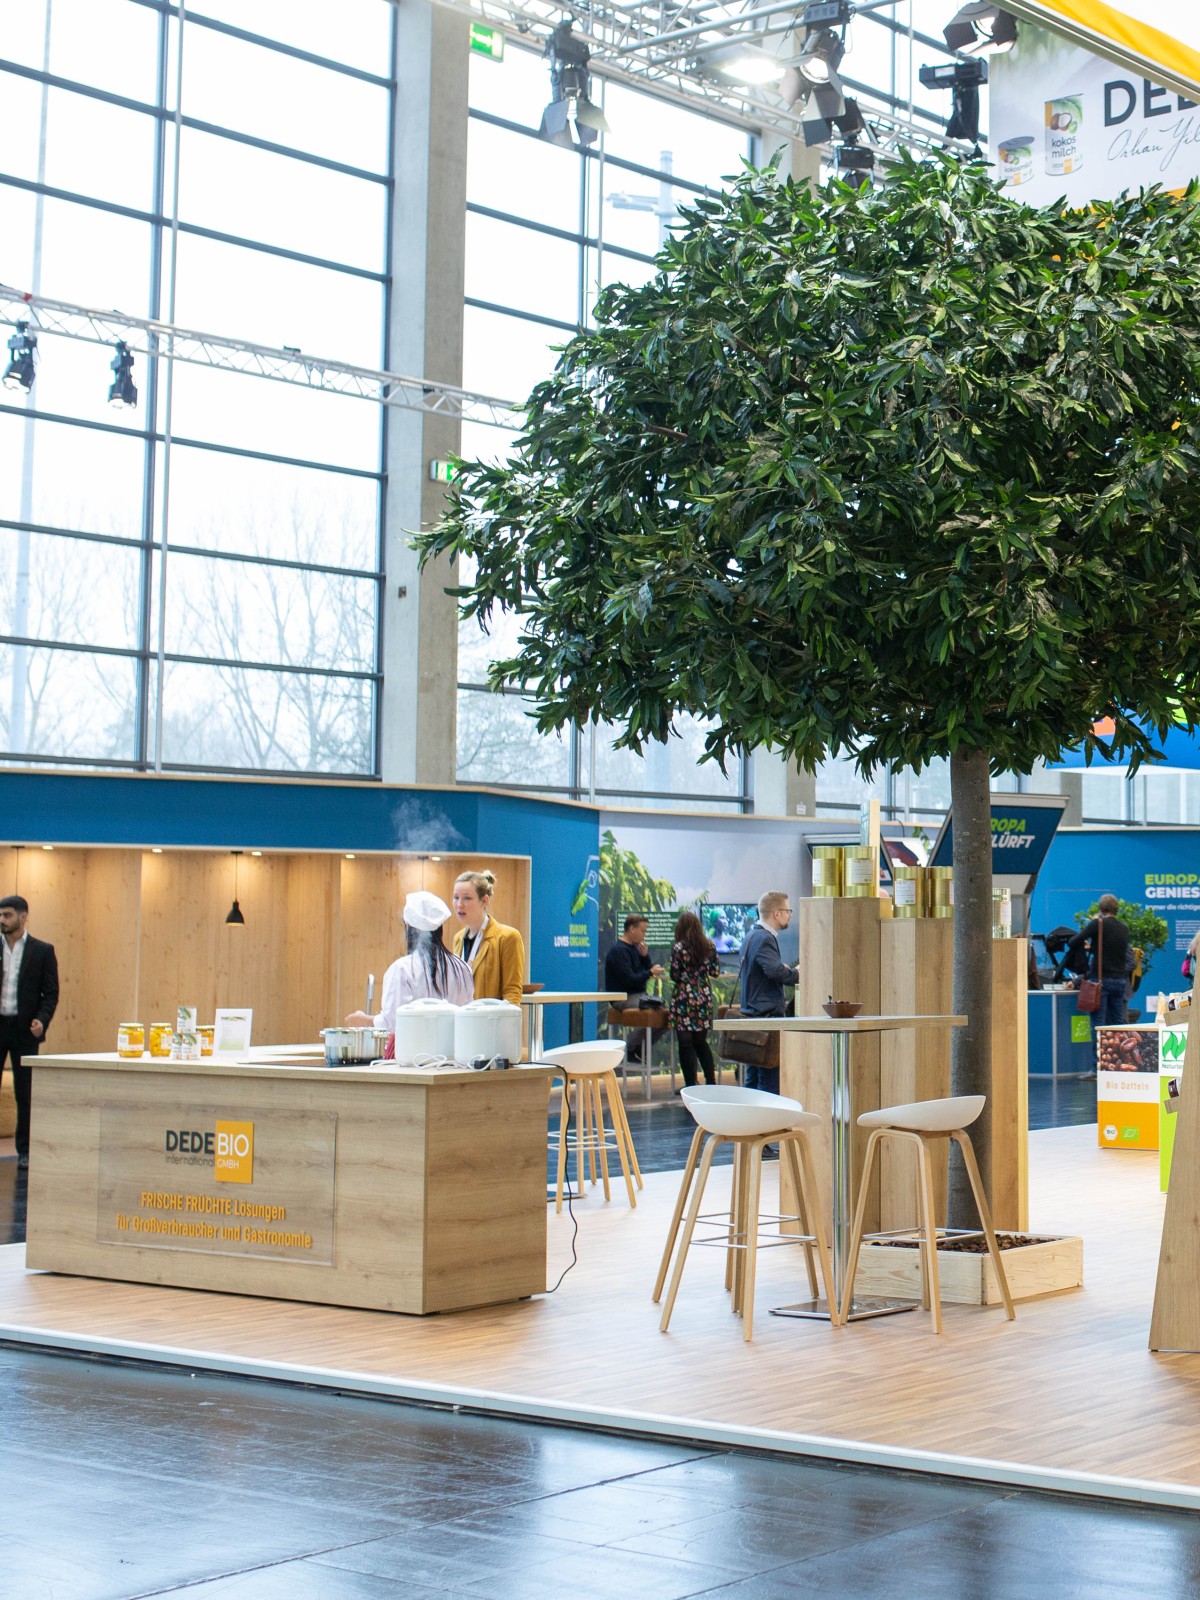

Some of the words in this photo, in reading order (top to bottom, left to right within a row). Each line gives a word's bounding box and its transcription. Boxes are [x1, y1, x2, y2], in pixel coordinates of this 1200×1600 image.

[1104, 79, 1200, 128] DE
[991, 817, 1027, 832] ROPA
[991, 831, 1036, 848] LÜRFT
[141, 1192, 184, 1211] FRISCHE
[186, 1194, 232, 1215] FRÜCHTE
[234, 1200, 286, 1223] Lösungen
[115, 1212, 131, 1231] für
[221, 1224, 241, 1242] und
[243, 1225, 313, 1249] Gastronomie
